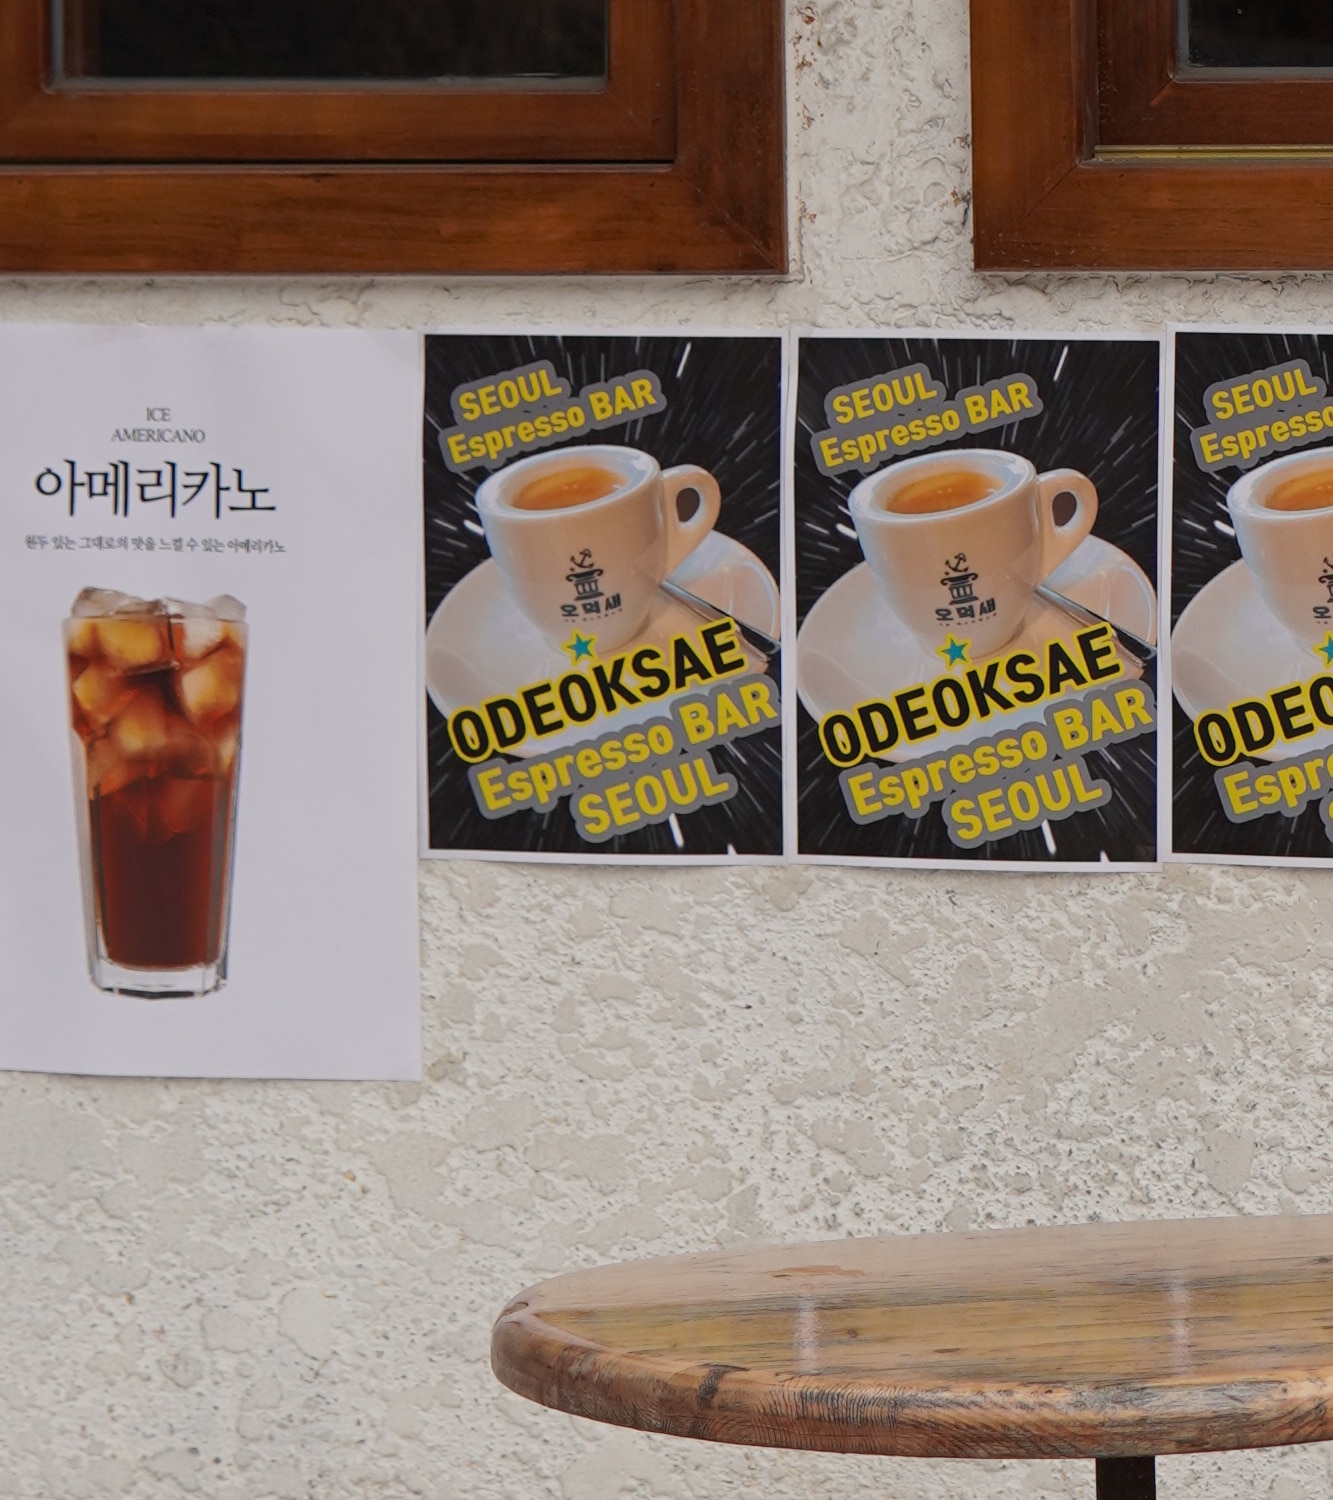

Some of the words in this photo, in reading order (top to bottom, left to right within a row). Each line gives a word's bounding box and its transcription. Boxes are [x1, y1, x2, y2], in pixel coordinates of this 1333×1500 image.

[146, 407, 172, 422] ICE
[446, 403, 585, 464] Espresso
[588, 378, 657, 420] BAR
[458, 368, 563, 422] SEOUL
[818, 409, 960, 468] Espresso
[967, 381, 1034, 424] BAR
[831, 372, 937, 425] SEOUL
[1211, 368, 1318, 420] SEOUL
[111, 428, 206, 443] AMERICANO
[34, 459, 277, 520] 아메리카노
[450, 619, 747, 762] ODEOKSAE
[820, 624, 1123, 766] ODEOKSAE
[477, 722, 674, 811] Espresso
[680, 682, 778, 745] BAR
[848, 728, 1047, 817] Espresso
[1053, 687, 1153, 750] BAR
[577, 759, 729, 835] SEOUL
[950, 763, 1103, 841] SEOUL
